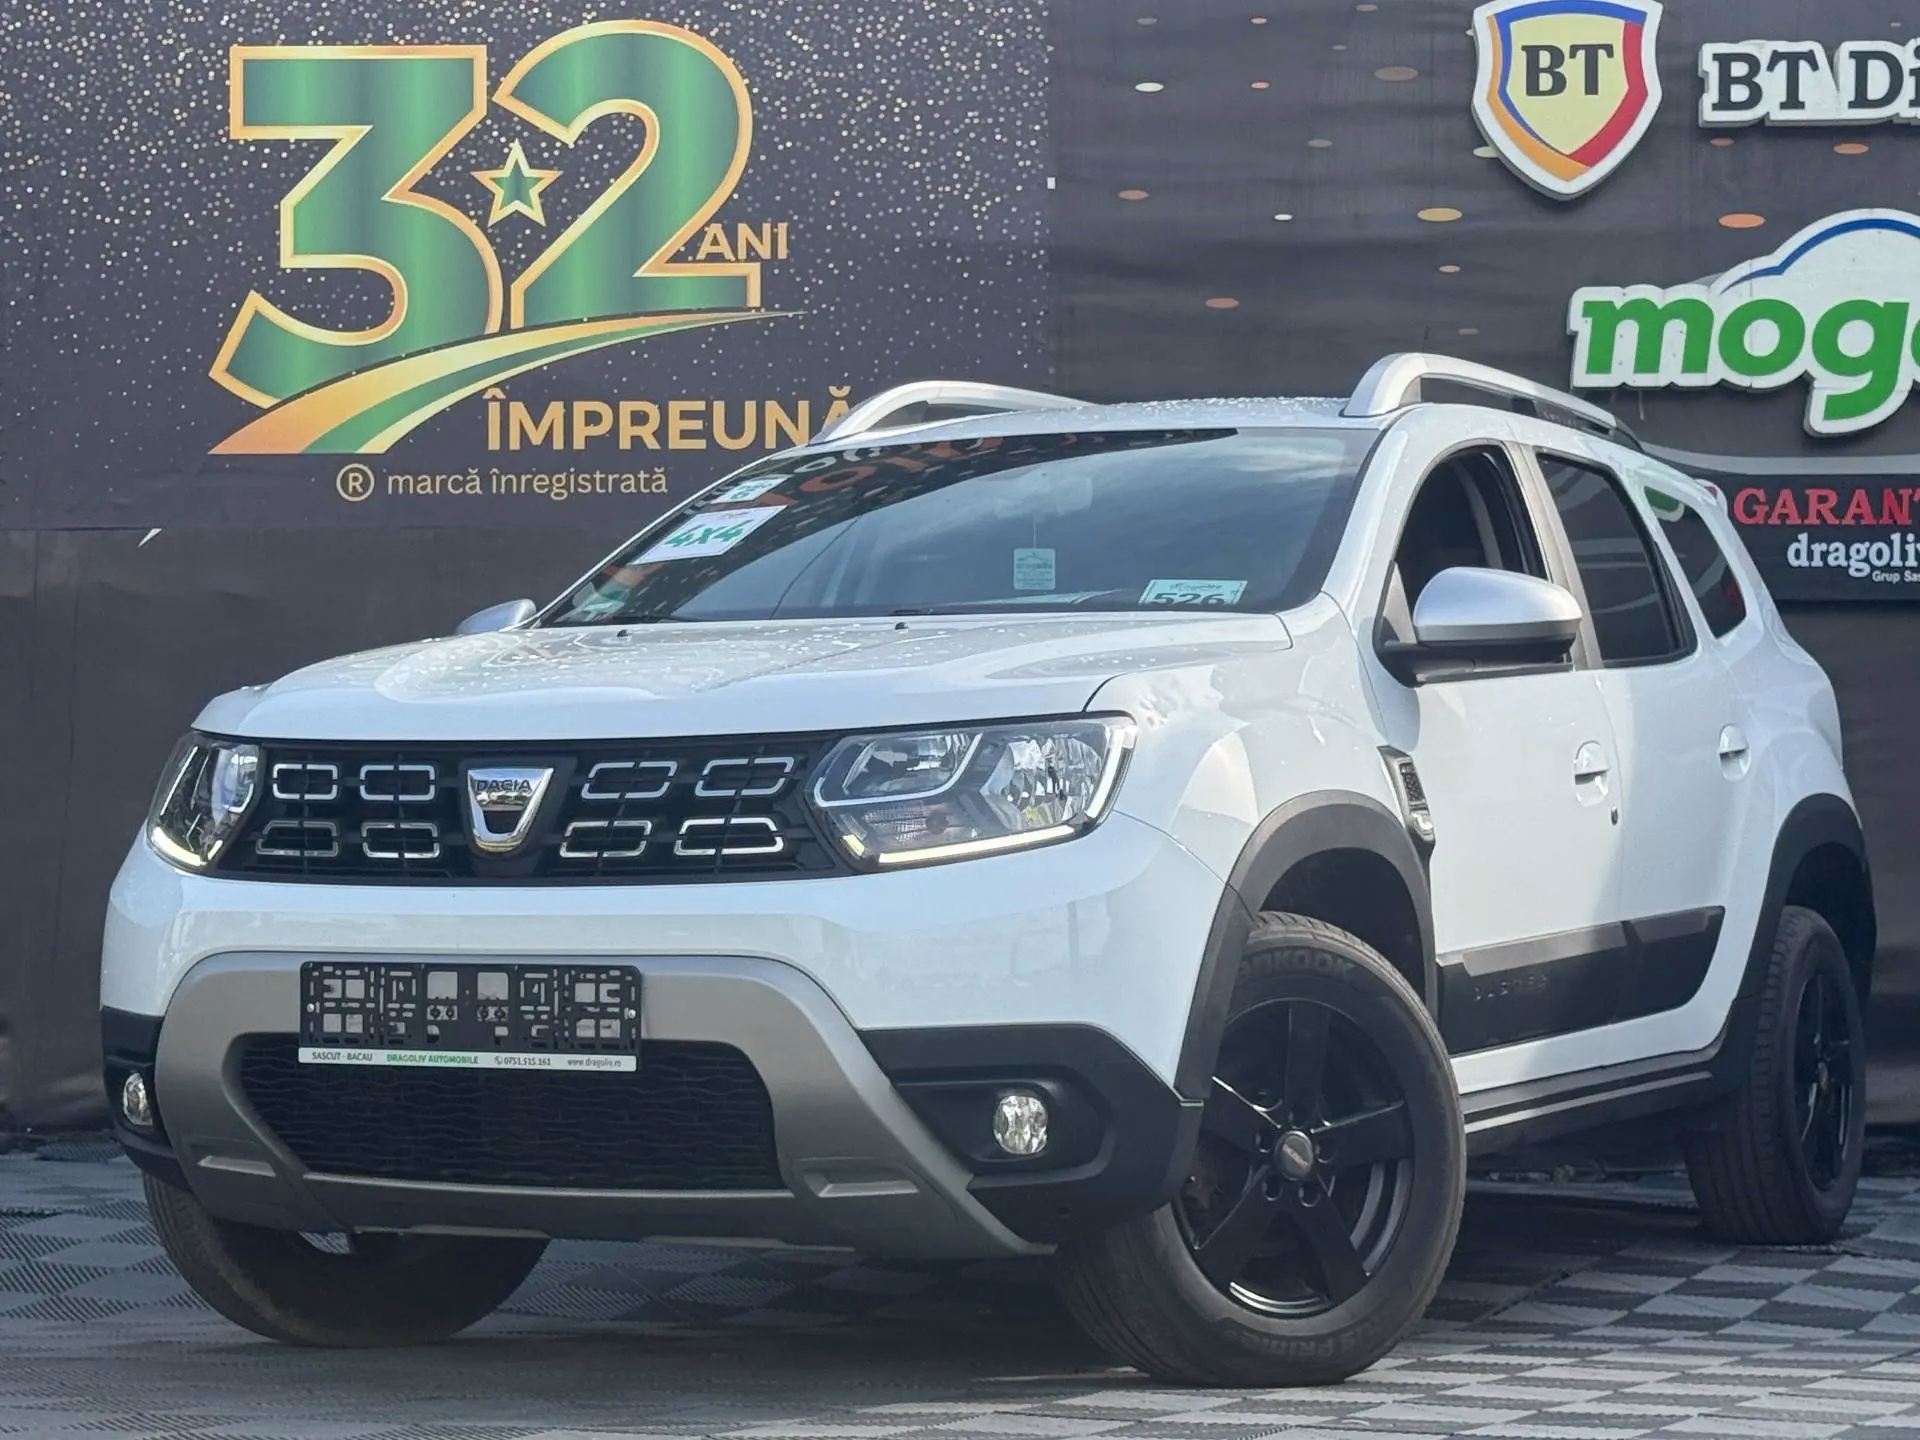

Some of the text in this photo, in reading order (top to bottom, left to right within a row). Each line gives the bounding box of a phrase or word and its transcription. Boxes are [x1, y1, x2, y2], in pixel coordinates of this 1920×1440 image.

[1521, 43, 1614, 97] BT
[1710, 49, 1820, 112] BT
[209, 20, 760, 409] 32
[695, 222, 789, 261] ANI
[1581, 298, 1920, 421] mog
[387, 468, 482, 495] marcă
[491, 467, 668, 500] înregistrată
[1733, 487, 1920, 526] GARAN
[1787, 532, 1920, 578] dragoli
[1871, 569, 1900, 584] Grup
[476, 779, 533, 792] DACIA
[312, 1051, 341, 1061] SASCUT
[386, 1053, 426, 1063] DRAGOLIV
[428, 1054, 479, 1065] AUTOMOBILE
[567, 1056, 622, 1068] www.dragoliv.ro
